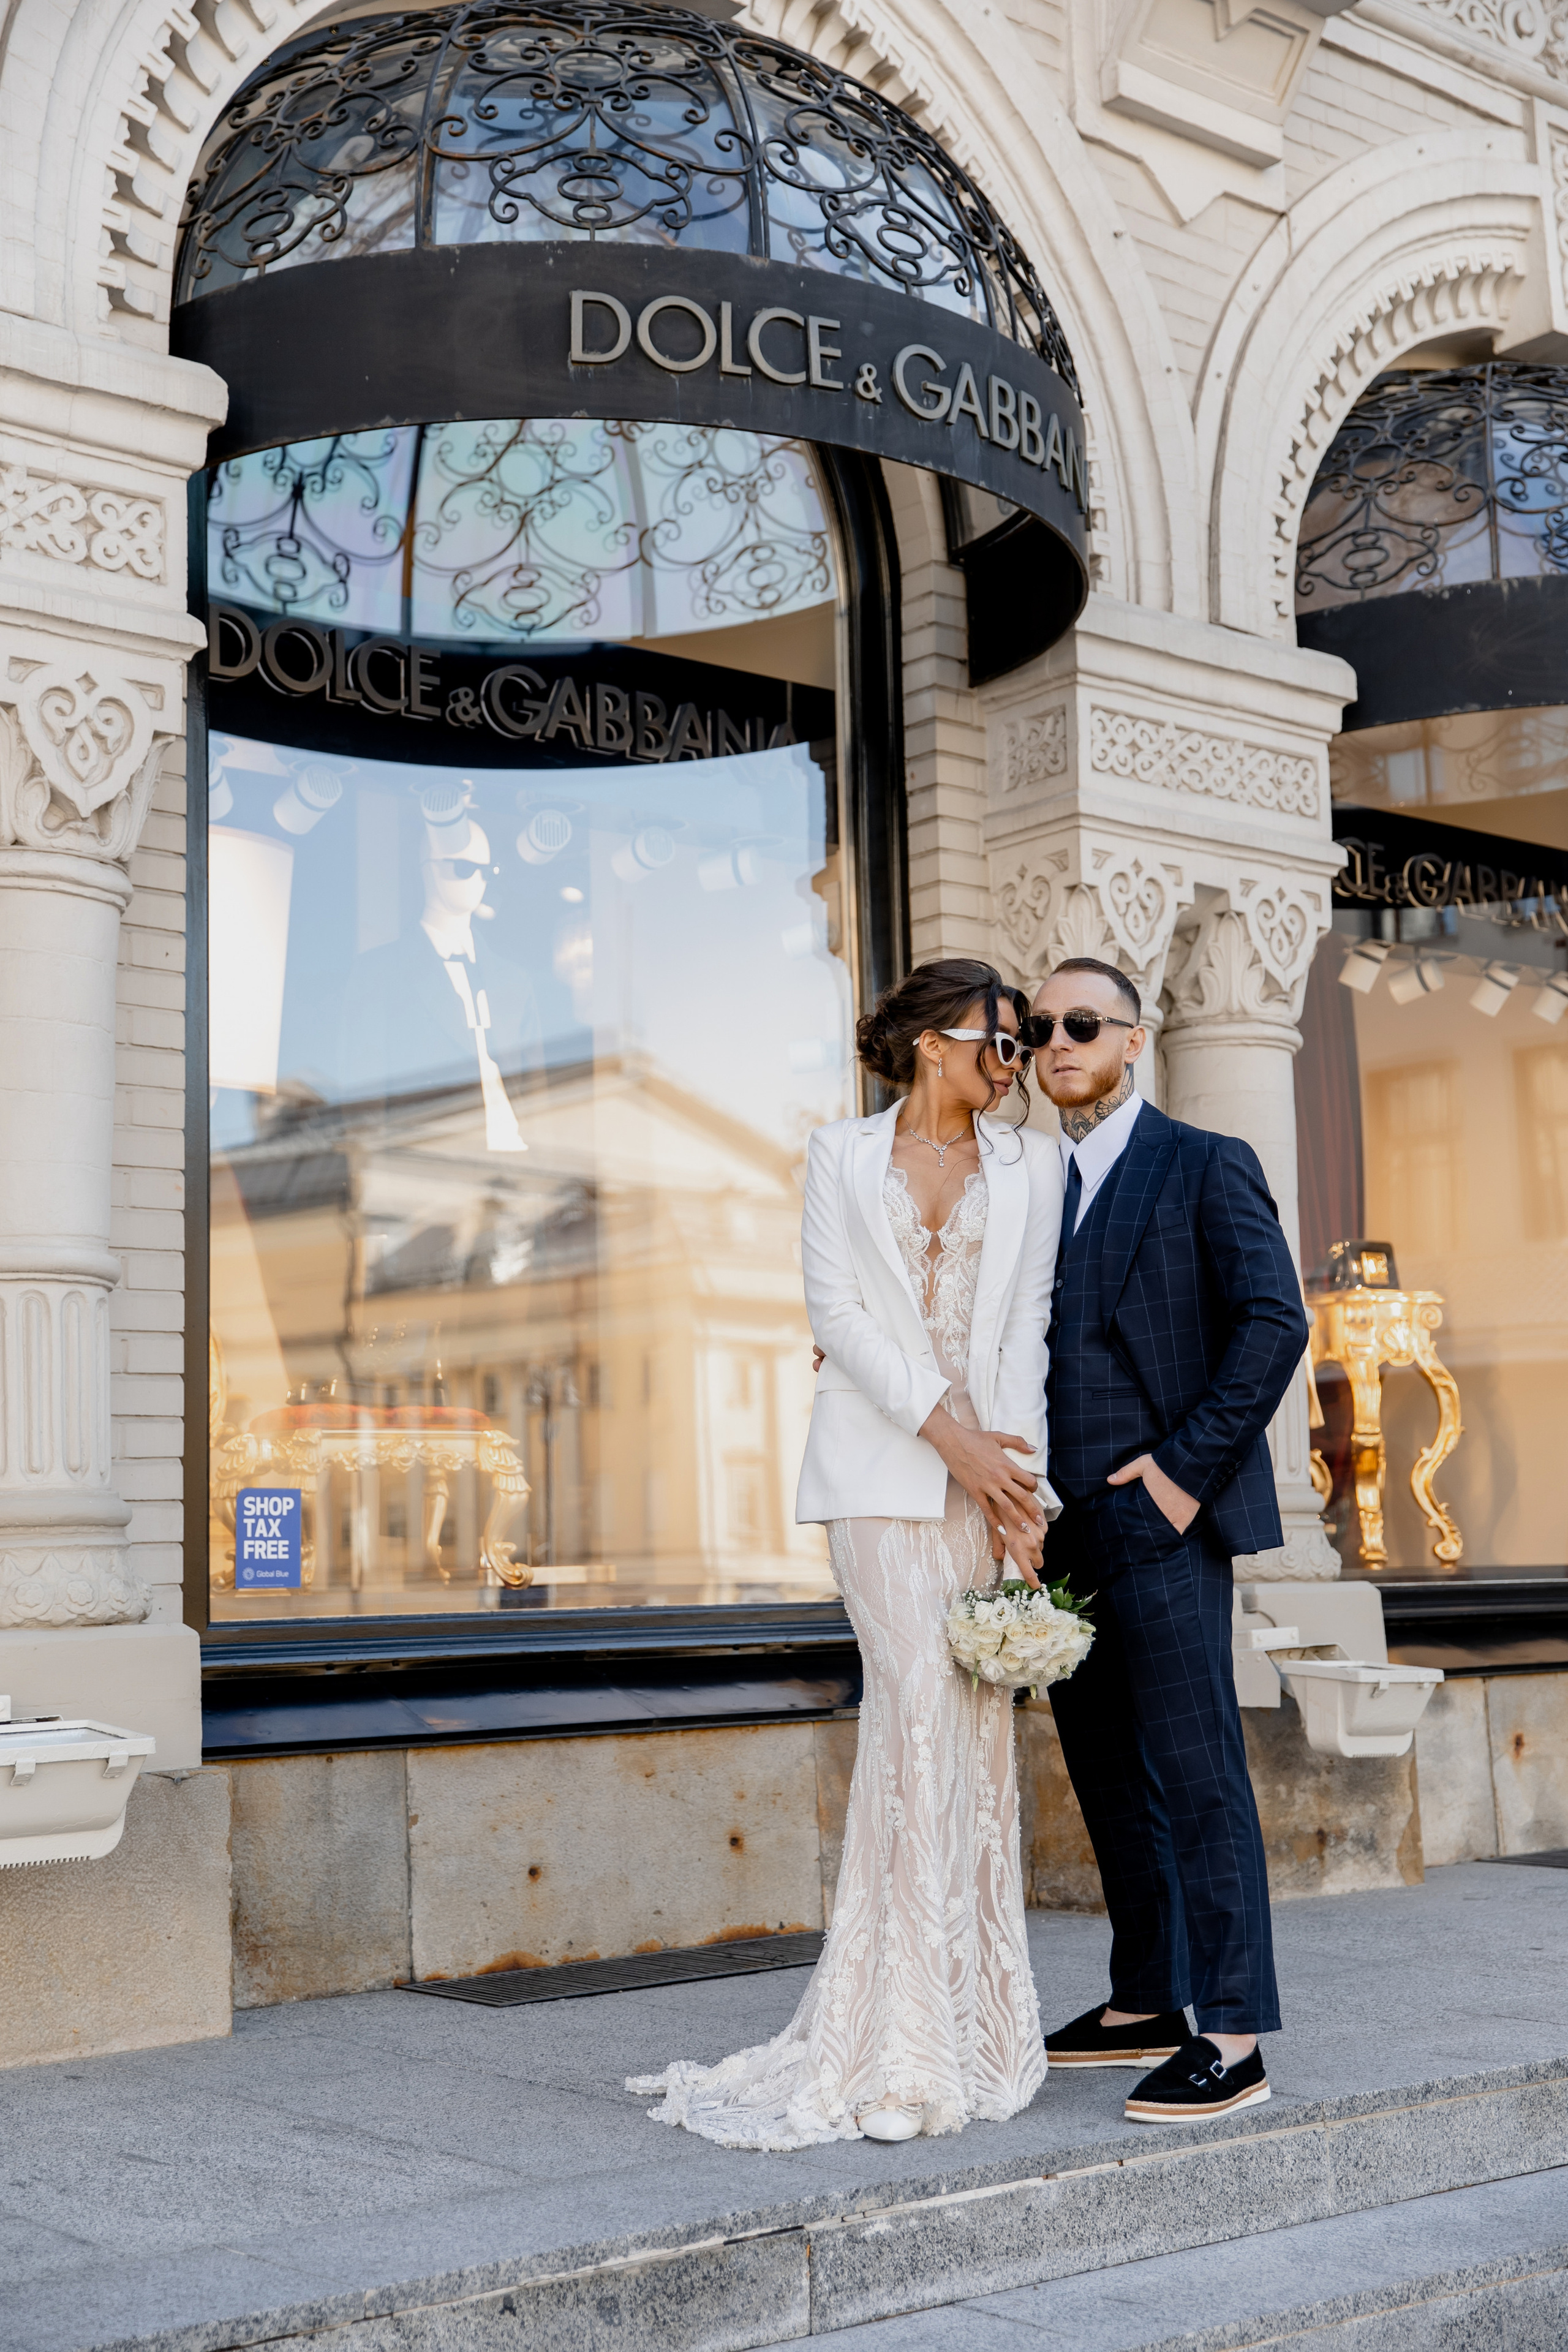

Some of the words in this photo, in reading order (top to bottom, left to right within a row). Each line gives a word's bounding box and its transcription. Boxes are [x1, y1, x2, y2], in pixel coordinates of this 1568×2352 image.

[569, 289, 844, 390] DOLCE
[856, 362, 883, 404] &
[893, 344, 1091, 532] GABBAN
[208, 603, 442, 720] DOLCE
[445, 686, 483, 728] &
[243, 1496, 295, 1516] SHOP
[243, 1518, 282, 1537] TAX
[243, 1540, 289, 1559] FREE
